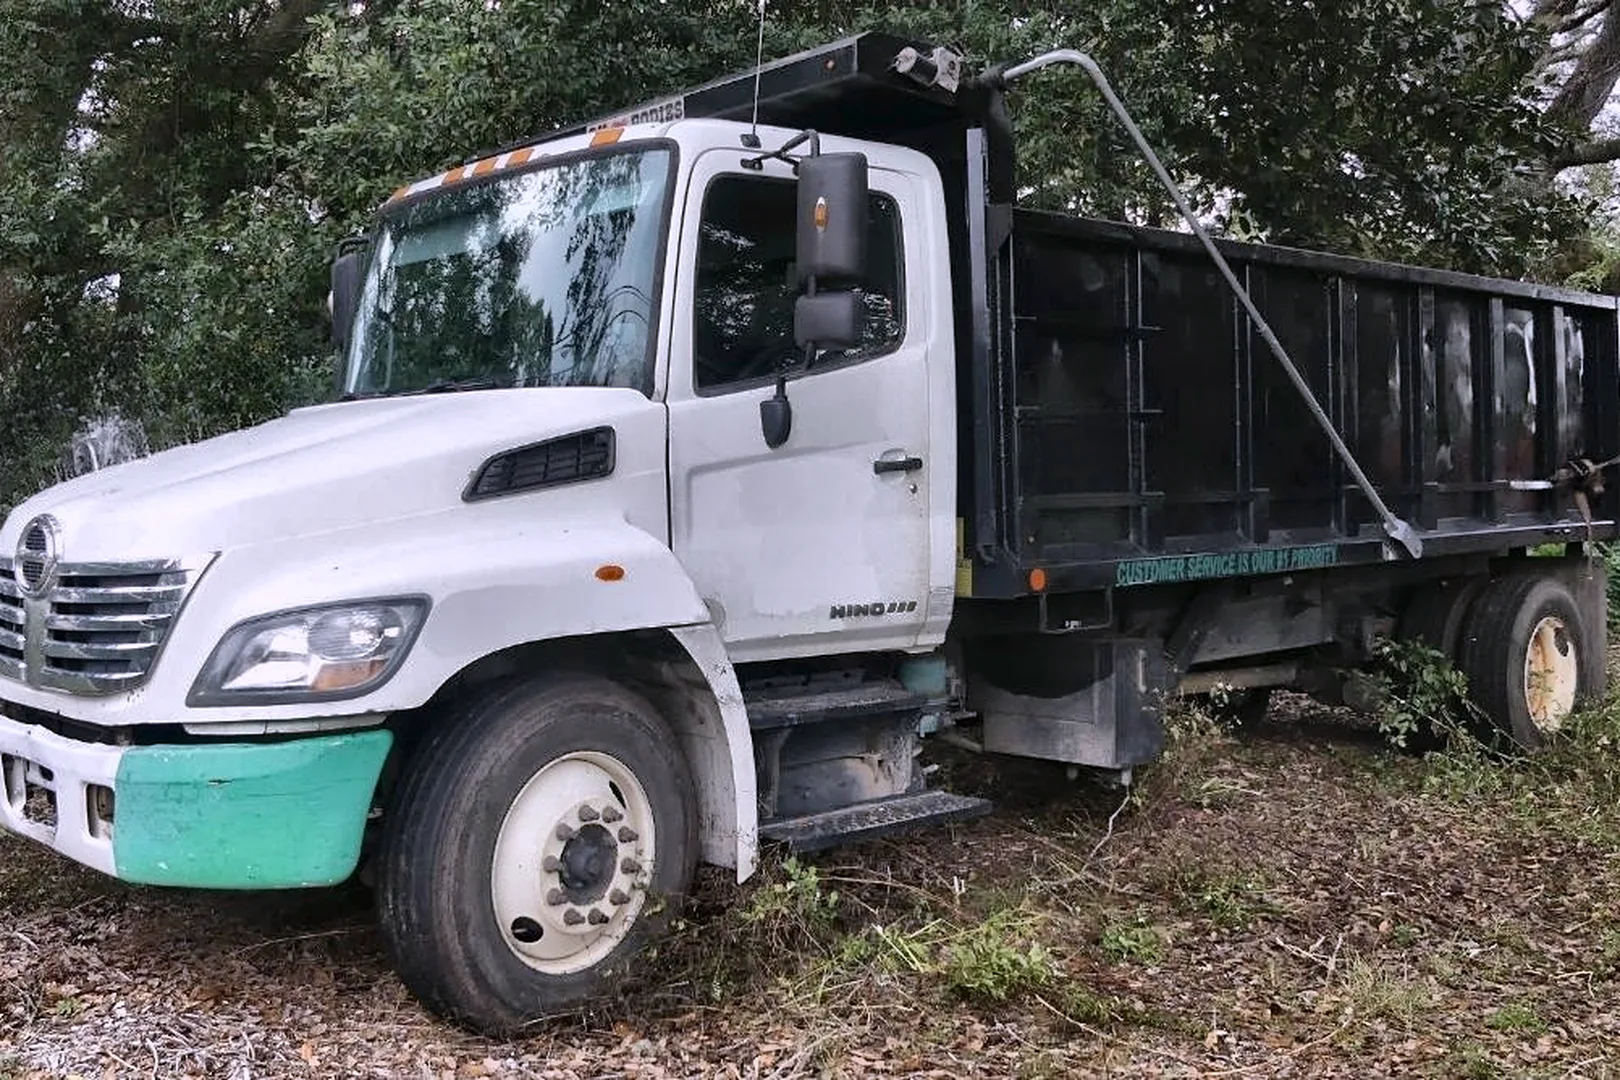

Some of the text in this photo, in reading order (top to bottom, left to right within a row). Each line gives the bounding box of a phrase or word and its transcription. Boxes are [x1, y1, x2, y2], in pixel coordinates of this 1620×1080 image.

[1116, 559, 1185, 585] CUSTOMER
[1187, 554, 1236, 579] SERVICE
[1238, 553, 1249, 573] IS
[1251, 551, 1275, 572] OUR
[830, 603, 885, 619] HINO
